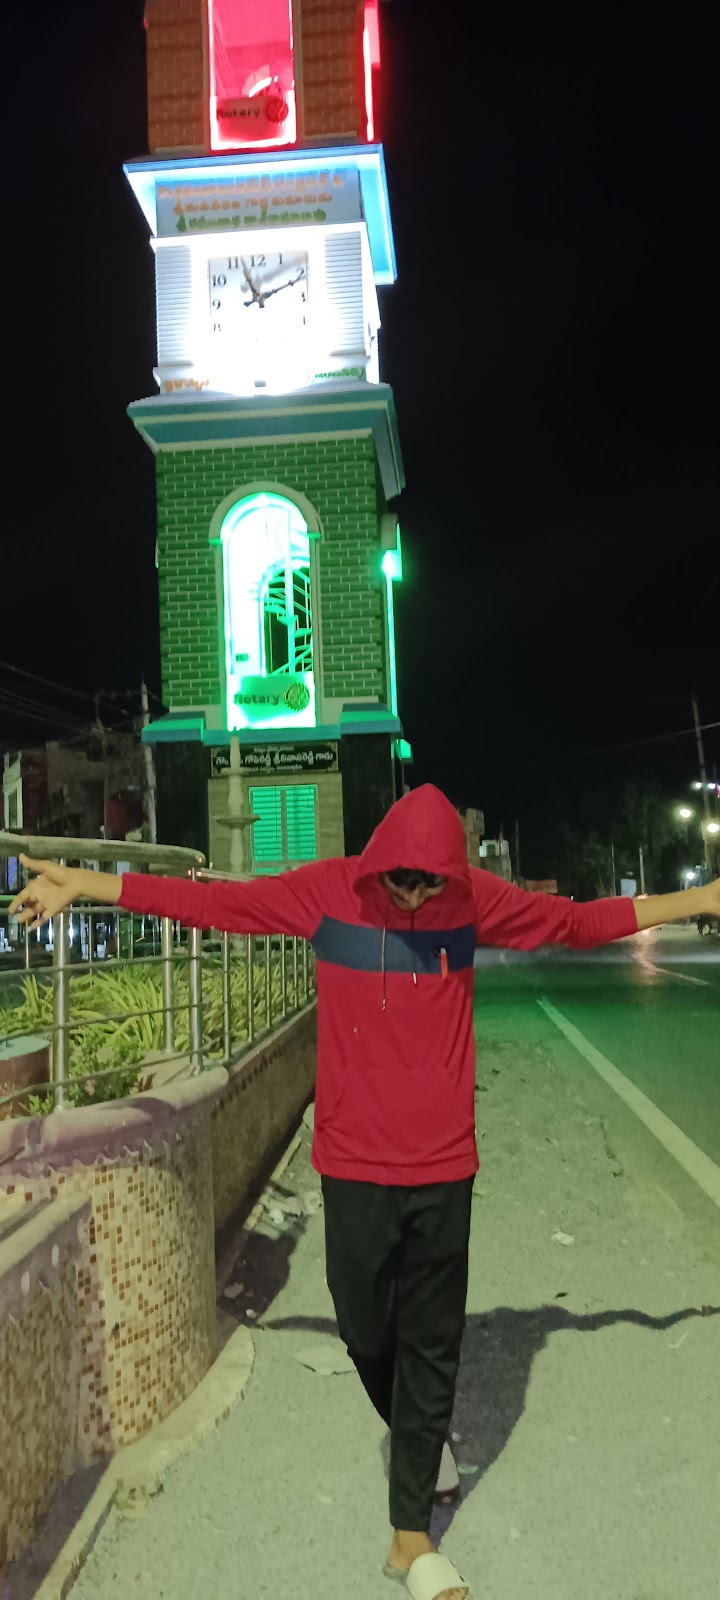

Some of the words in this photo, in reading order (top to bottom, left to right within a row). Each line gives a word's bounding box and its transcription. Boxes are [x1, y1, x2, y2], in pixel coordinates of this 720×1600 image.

[217, 108, 260, 121] Rotary
[227, 256, 239, 270] 11
[250, 254, 266, 268] 12
[278, 252, 283, 266] 1
[212, 273, 226, 286] 10
[212, 298, 221, 310] 9
[234, 693, 280, 706] Rotary
